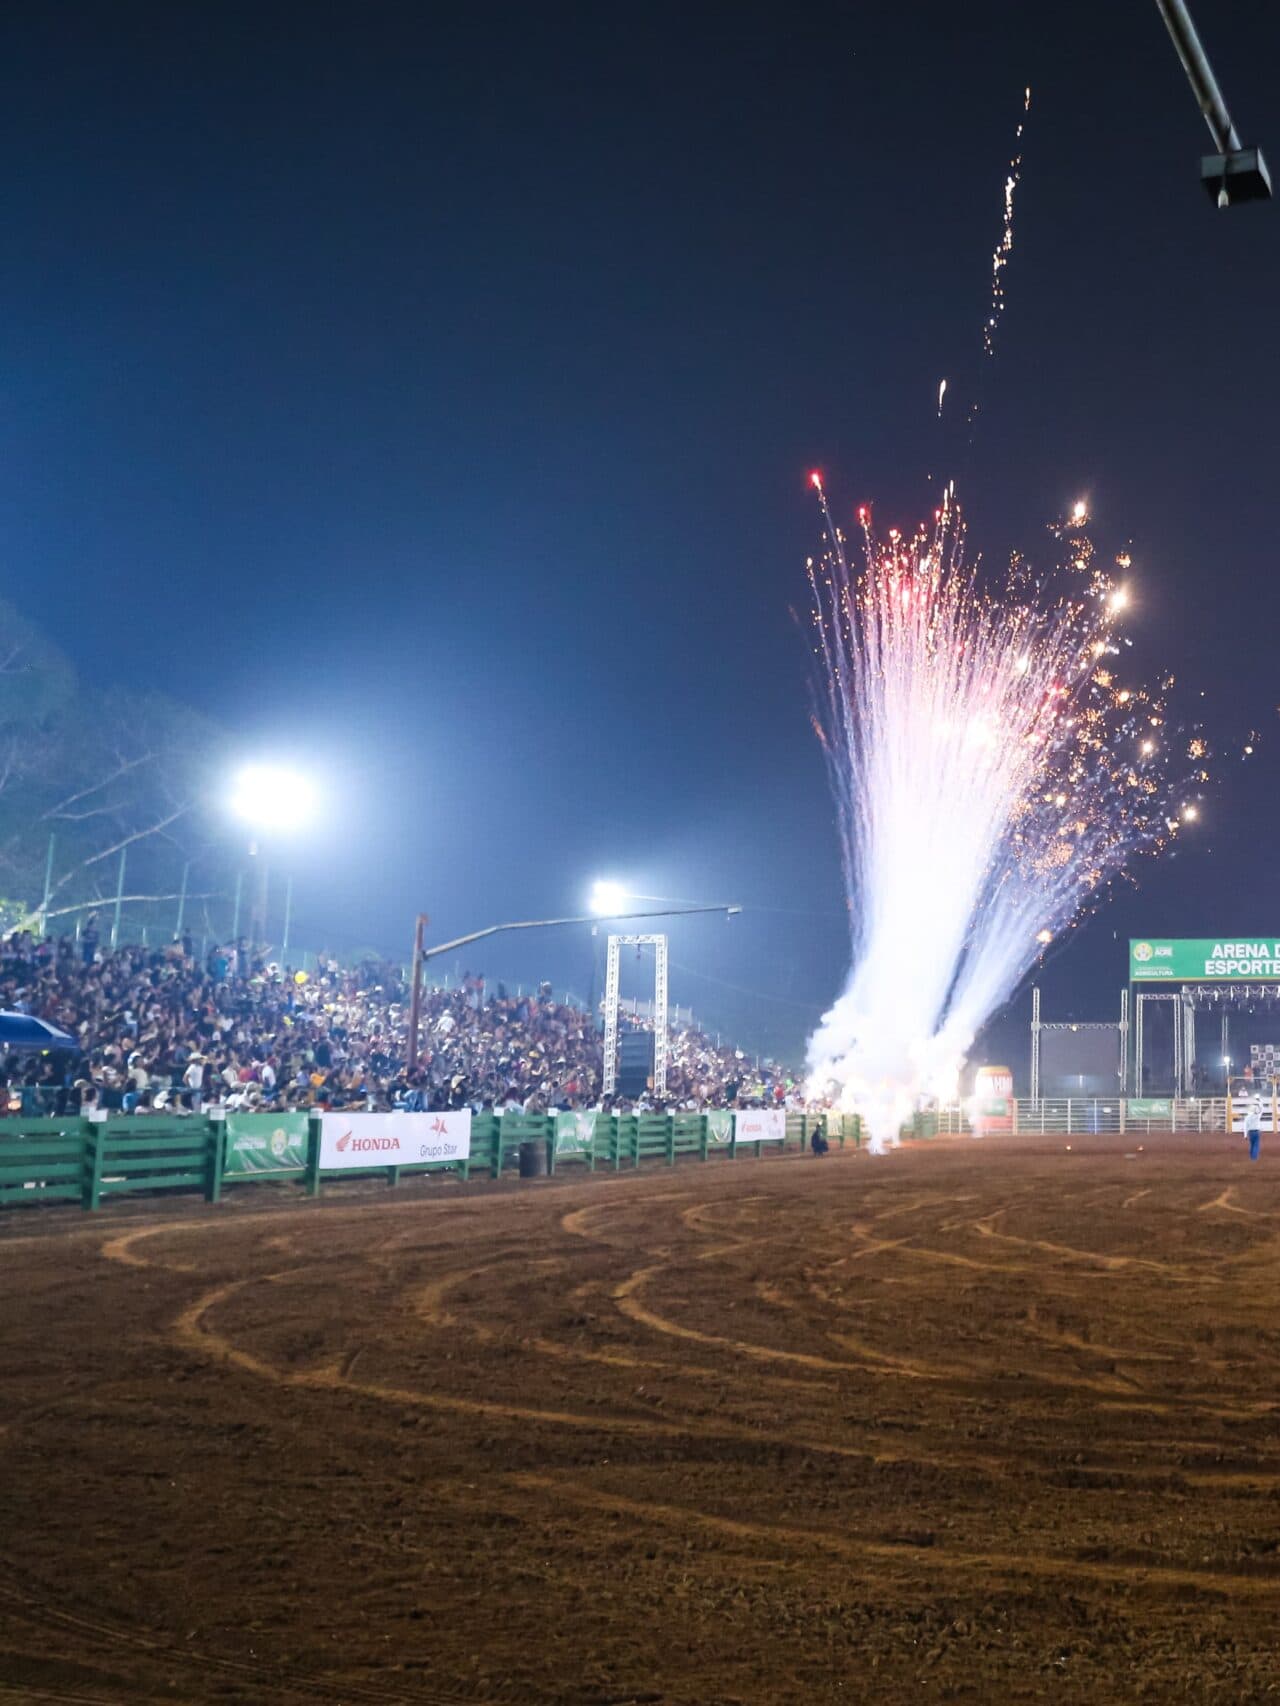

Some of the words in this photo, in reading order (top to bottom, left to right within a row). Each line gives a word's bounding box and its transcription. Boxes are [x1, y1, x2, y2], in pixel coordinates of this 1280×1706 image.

[1211, 943, 1270, 959] ARENA
[352, 1138, 401, 1151] HONDA
[420, 1144, 442, 1158] Grupo
[443, 1143, 458, 1155] Star
